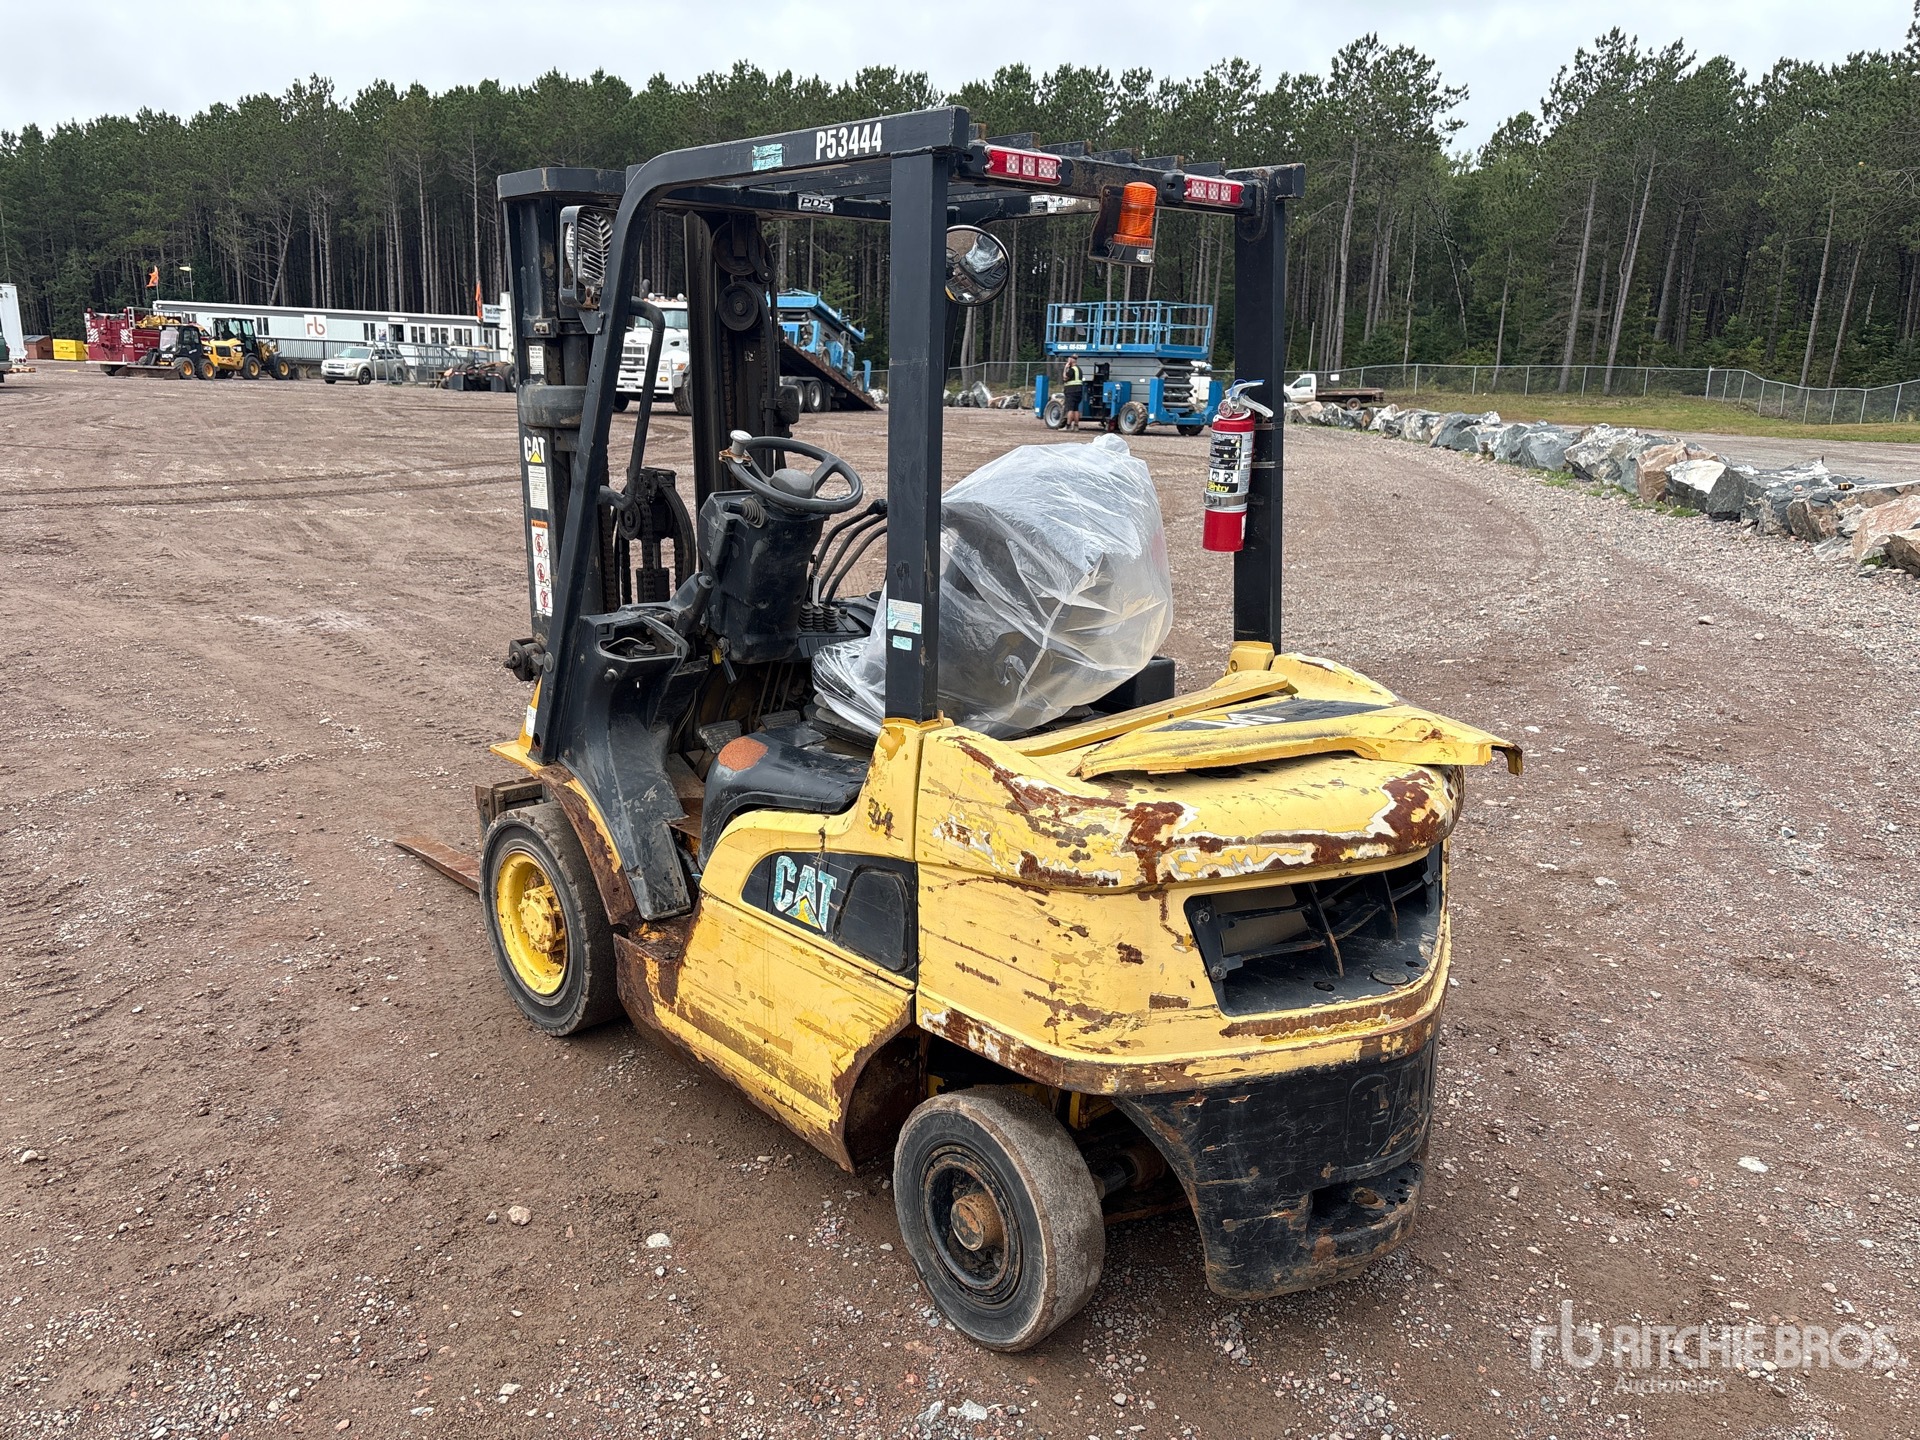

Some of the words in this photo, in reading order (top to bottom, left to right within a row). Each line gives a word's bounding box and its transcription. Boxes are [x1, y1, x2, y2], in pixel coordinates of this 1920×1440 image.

[815, 122, 882, 160] P53444
[801, 198, 831, 207] PDS
[306, 316, 326, 335] rb
[523, 436, 546, 464] CAT
[773, 855, 838, 932] CAT
